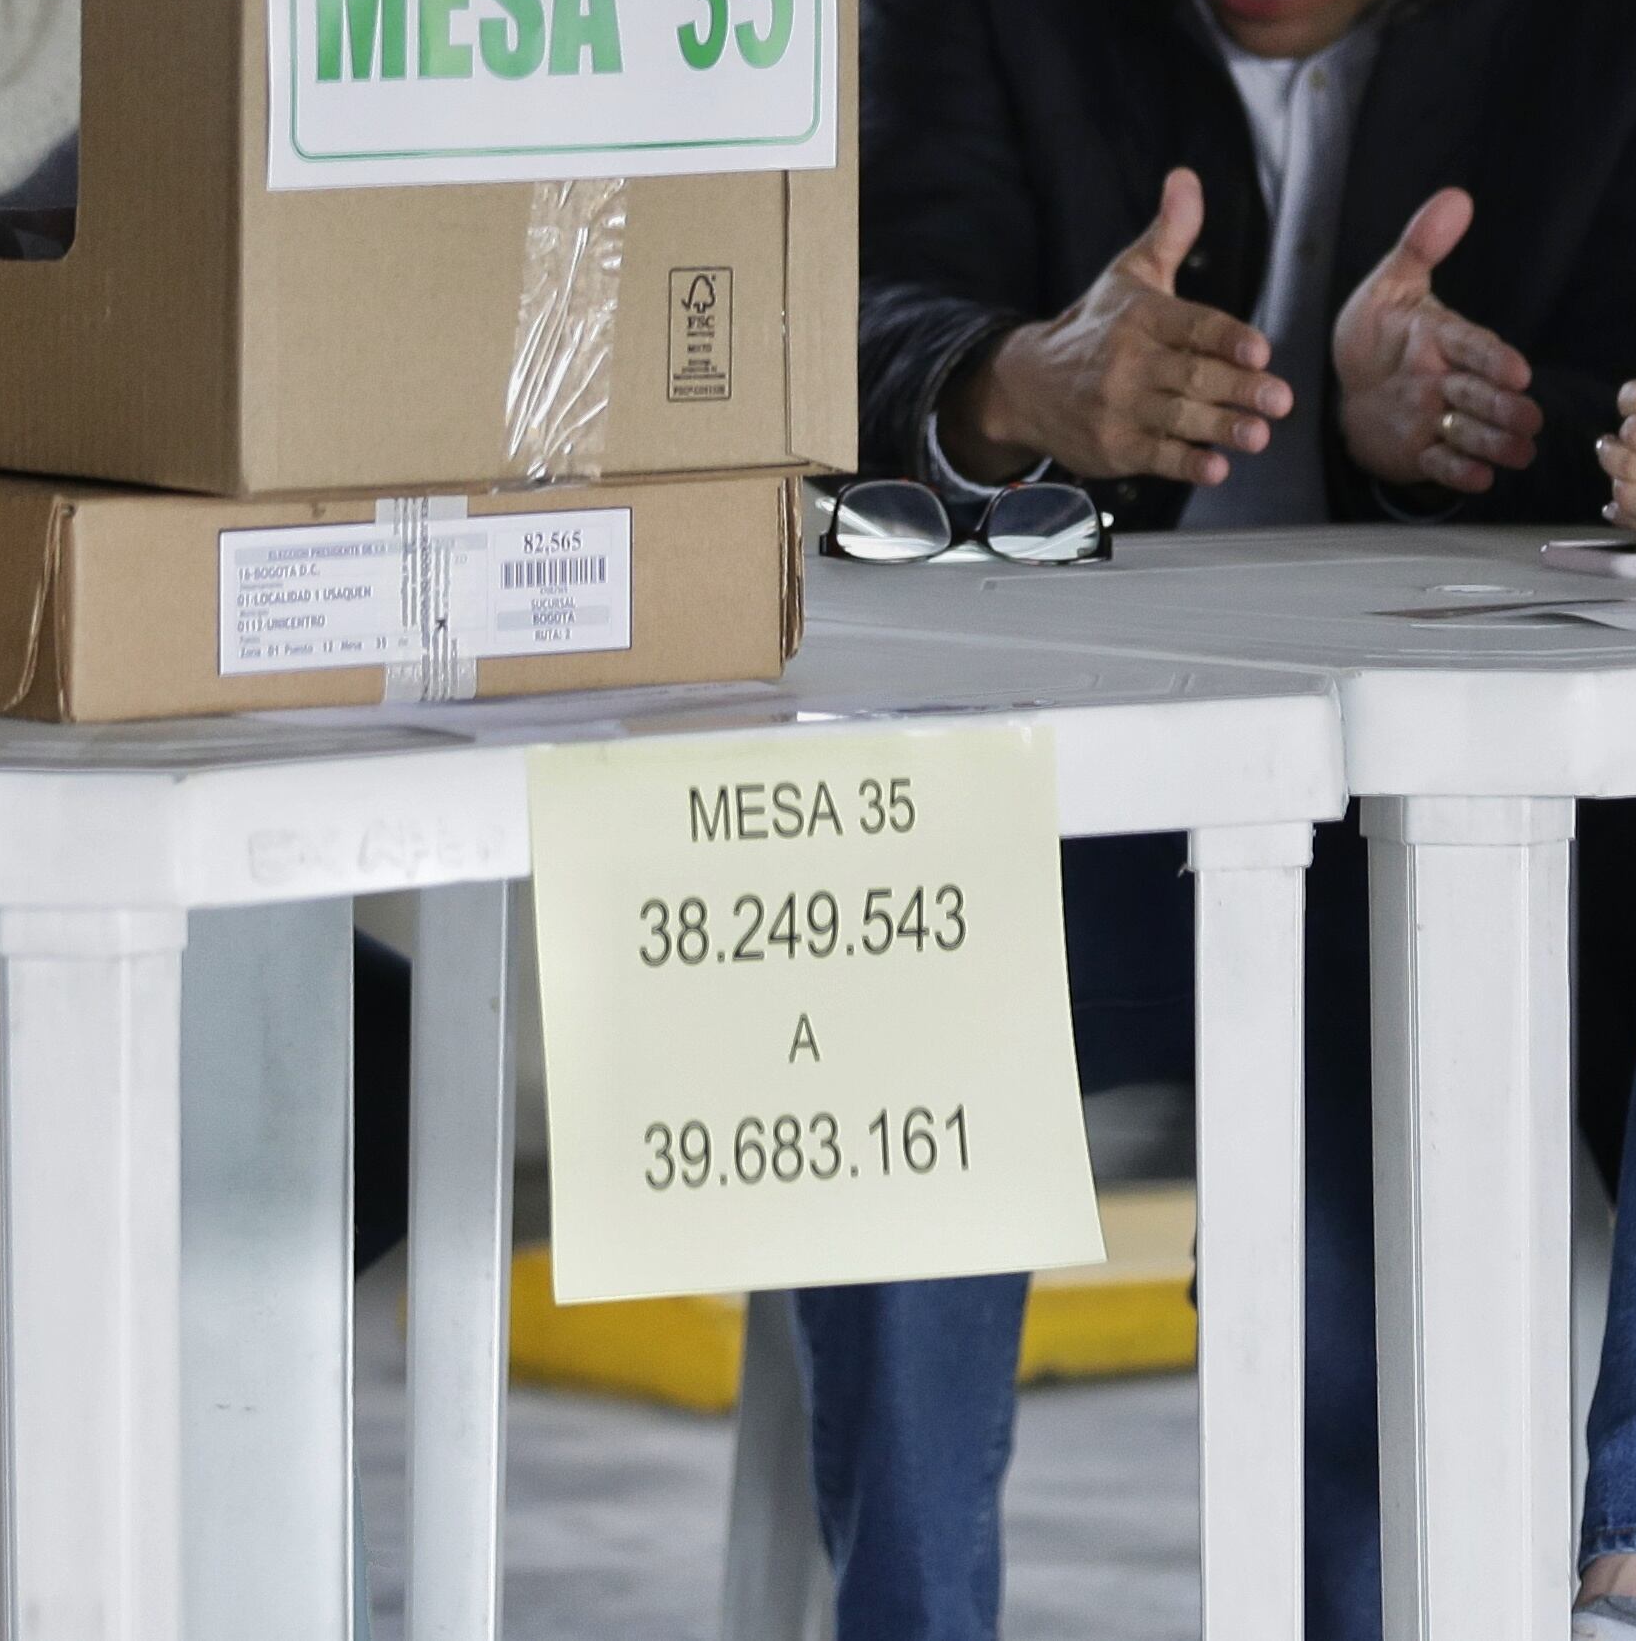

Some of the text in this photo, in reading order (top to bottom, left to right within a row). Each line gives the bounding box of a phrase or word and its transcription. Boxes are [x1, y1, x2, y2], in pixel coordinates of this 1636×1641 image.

[523, 529, 582, 555] 82,565
[323, 585, 372, 602] USAQUEN
[531, 597, 577, 610] SUCURSAL
[532, 612, 576, 626] BOGOTA
[689, 778, 917, 842] MESA 35
[639, 884, 969, 967] 38.249.543
[788, 1014, 821, 1064] A
[644, 1104, 970, 1191] 39.683.161
